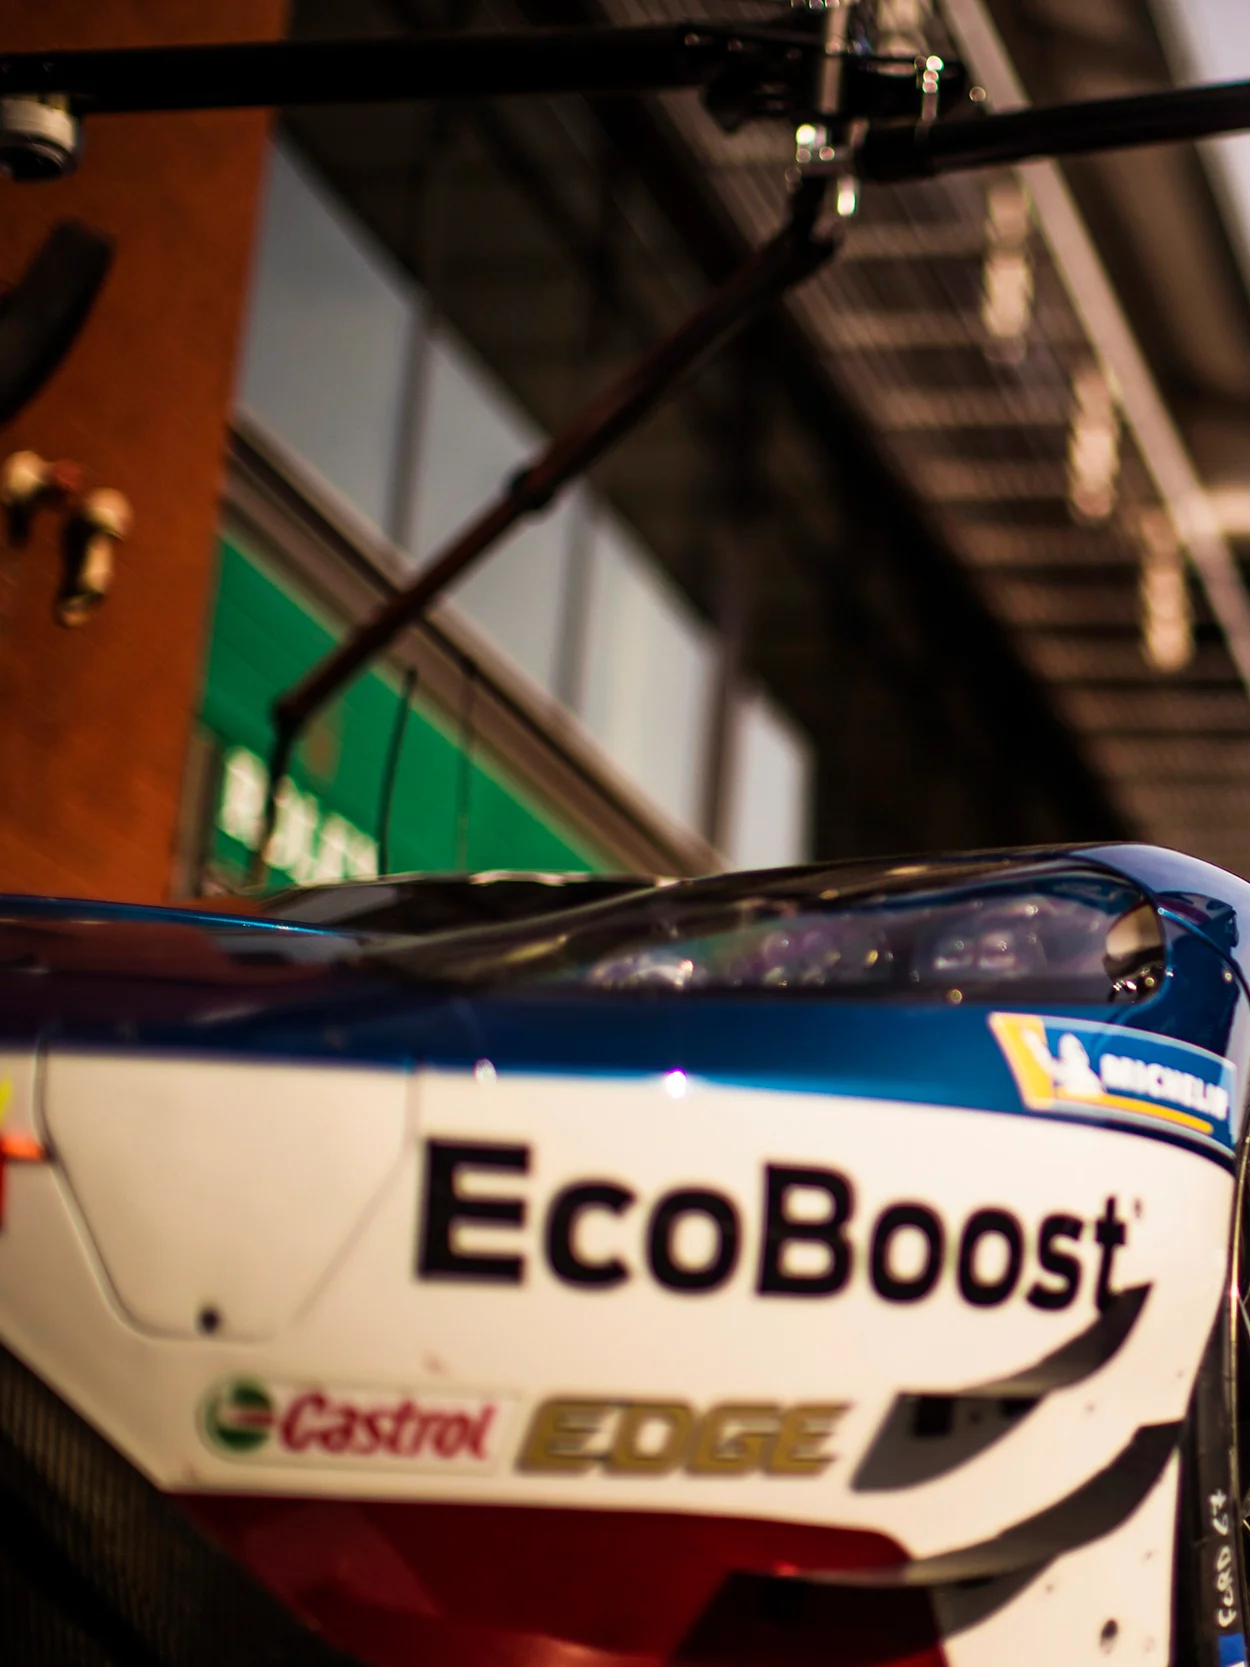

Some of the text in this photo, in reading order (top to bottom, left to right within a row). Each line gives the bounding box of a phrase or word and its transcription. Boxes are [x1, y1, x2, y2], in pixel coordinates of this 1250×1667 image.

[1100, 1053, 1229, 1120] MICHELIN
[414, 1137, 1128, 1314] EcoBoost
[280, 1393, 853, 1476] Castrol EDGE
